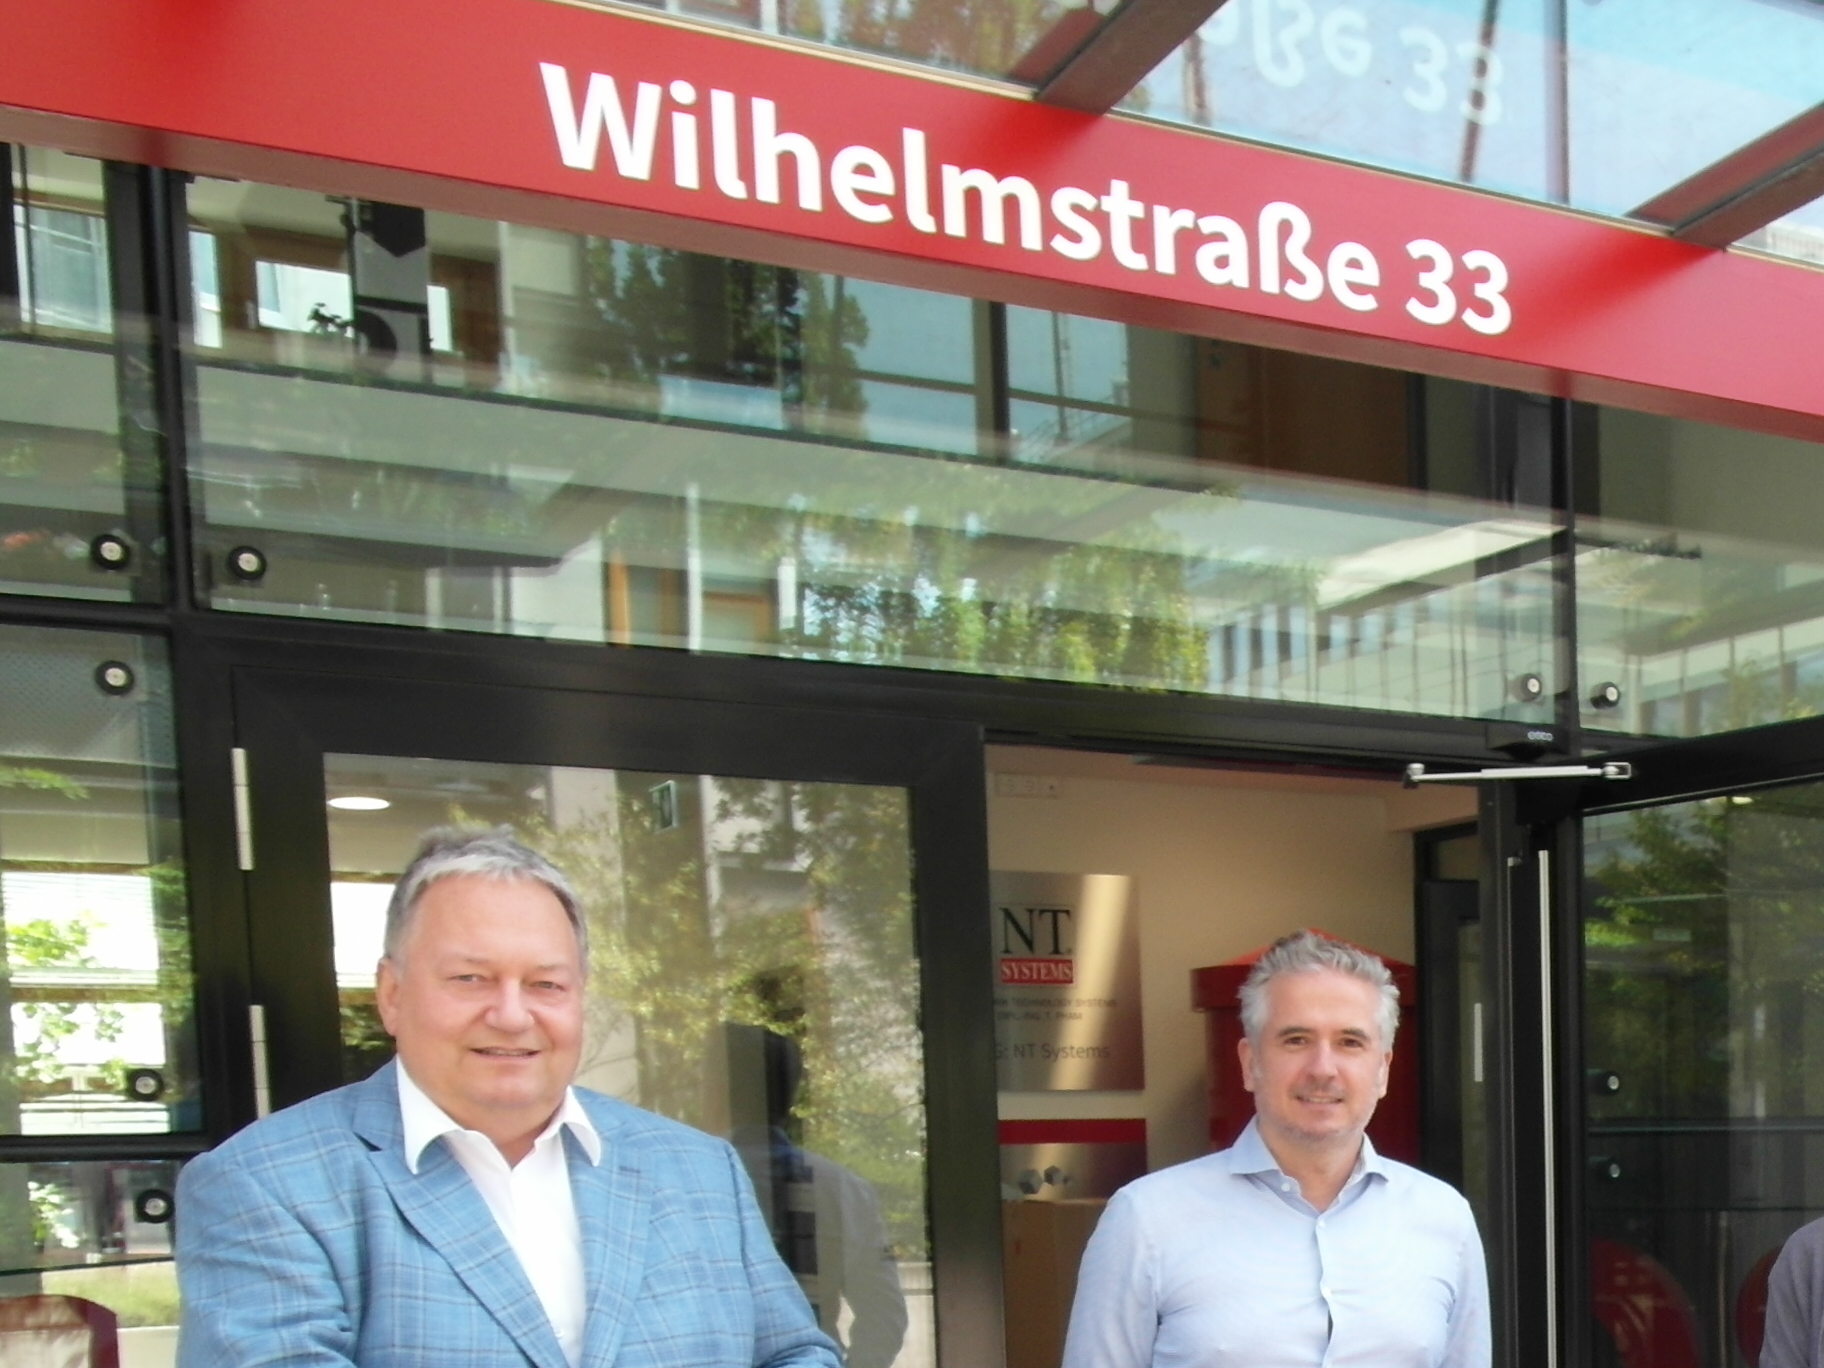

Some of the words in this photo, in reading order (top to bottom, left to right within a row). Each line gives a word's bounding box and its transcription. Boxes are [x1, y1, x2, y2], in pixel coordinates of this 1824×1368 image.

[539, 61, 1380, 312] Wilhelmstraße
[1404, 237, 1513, 336] 33
[999, 907, 1071, 954] NT
[1001, 961, 1073, 981] SYSTEMS
[1013, 1042, 1035, 1059] NT
[1041, 1042, 1110, 1063] Systems
